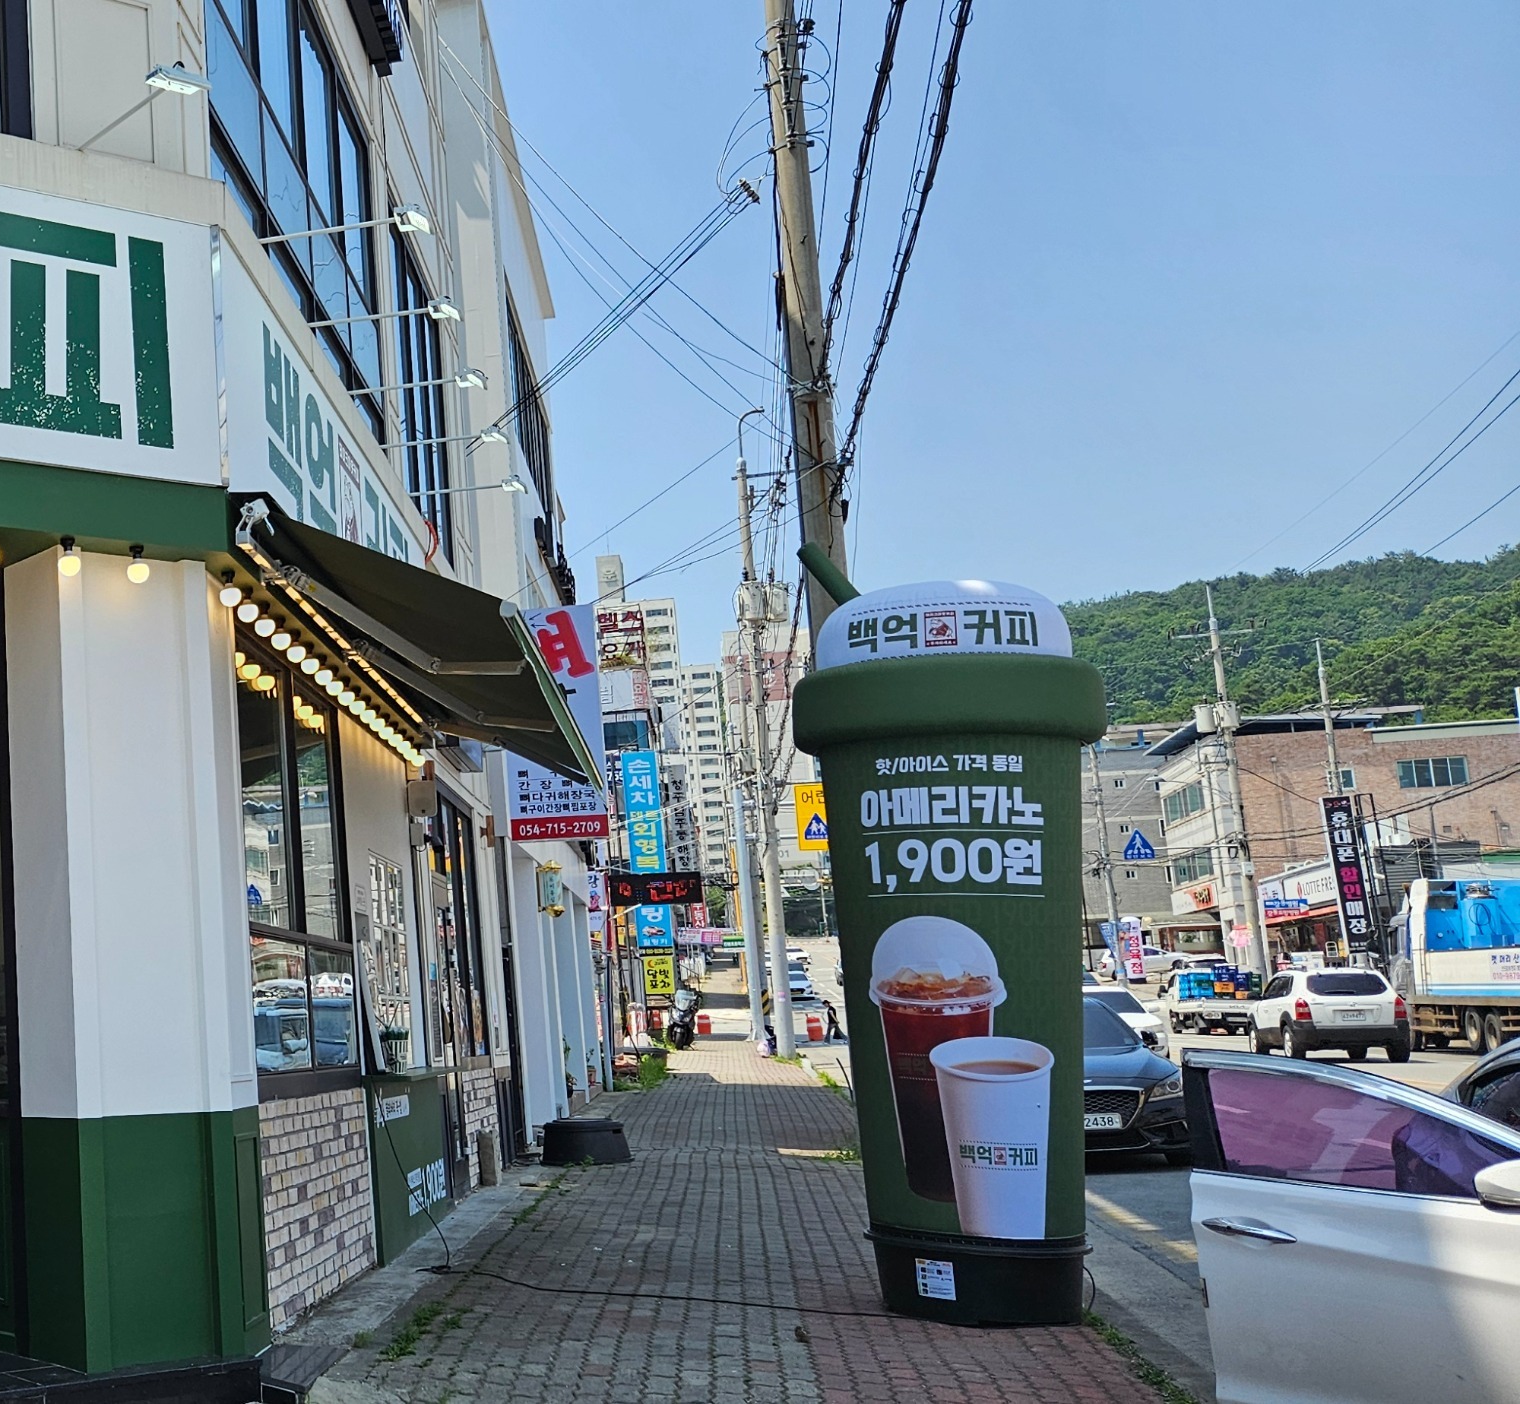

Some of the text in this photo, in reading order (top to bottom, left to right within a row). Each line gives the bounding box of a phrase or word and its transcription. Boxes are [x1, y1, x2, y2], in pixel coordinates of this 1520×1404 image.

[847, 609, 1039, 653] 백억 커피
[875, 754, 1023, 775] 핫/아이스 가격 동일
[627, 759, 656, 806] 손세차
[860, 785, 1045, 828] 아메리카노
[519, 821, 601, 836] 054-715-2709
[864, 837, 1043, 893] 1,900원
[1129, 934, 1144, 975] 정육점
[649, 979, 671, 990] 포차
[1084, 1116, 1114, 1128] 2438
[959, 1144, 1038, 1166] 백억 커피
